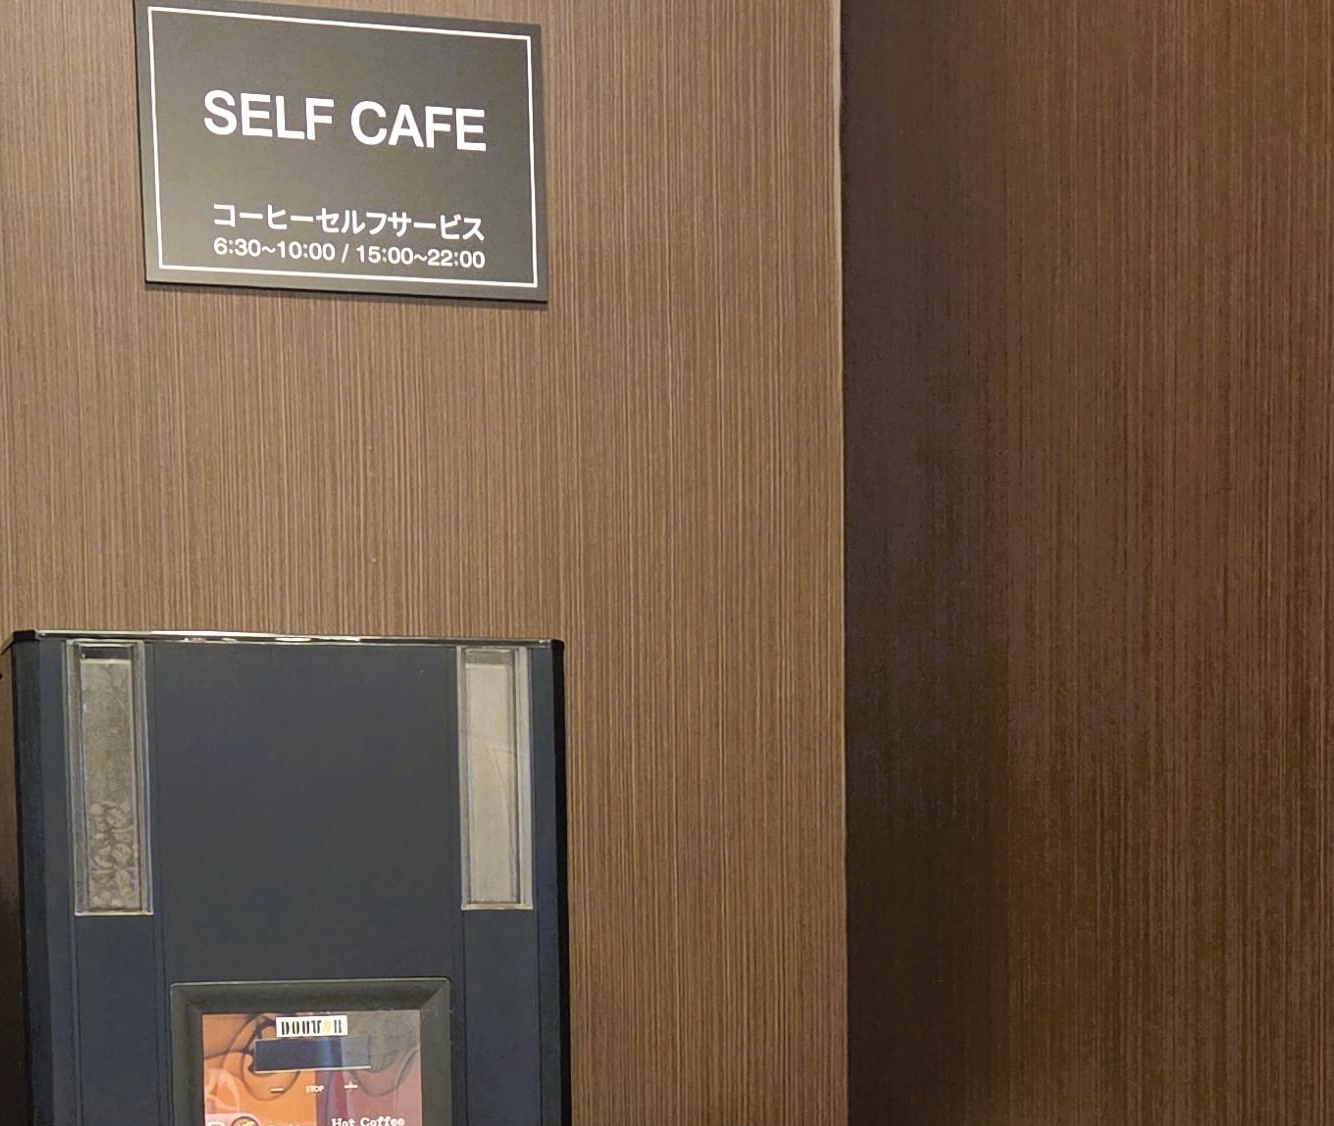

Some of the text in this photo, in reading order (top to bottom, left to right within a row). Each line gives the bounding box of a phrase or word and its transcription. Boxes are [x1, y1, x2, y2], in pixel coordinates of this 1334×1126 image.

[203, 89, 487, 152] SELF CAFE
[213, 204, 485, 241] コーヒーセルフサービス
[214, 238, 486, 269] 6:30~10:00 / 15:00~22:00
[306, 1085, 324, 1093] STOP
